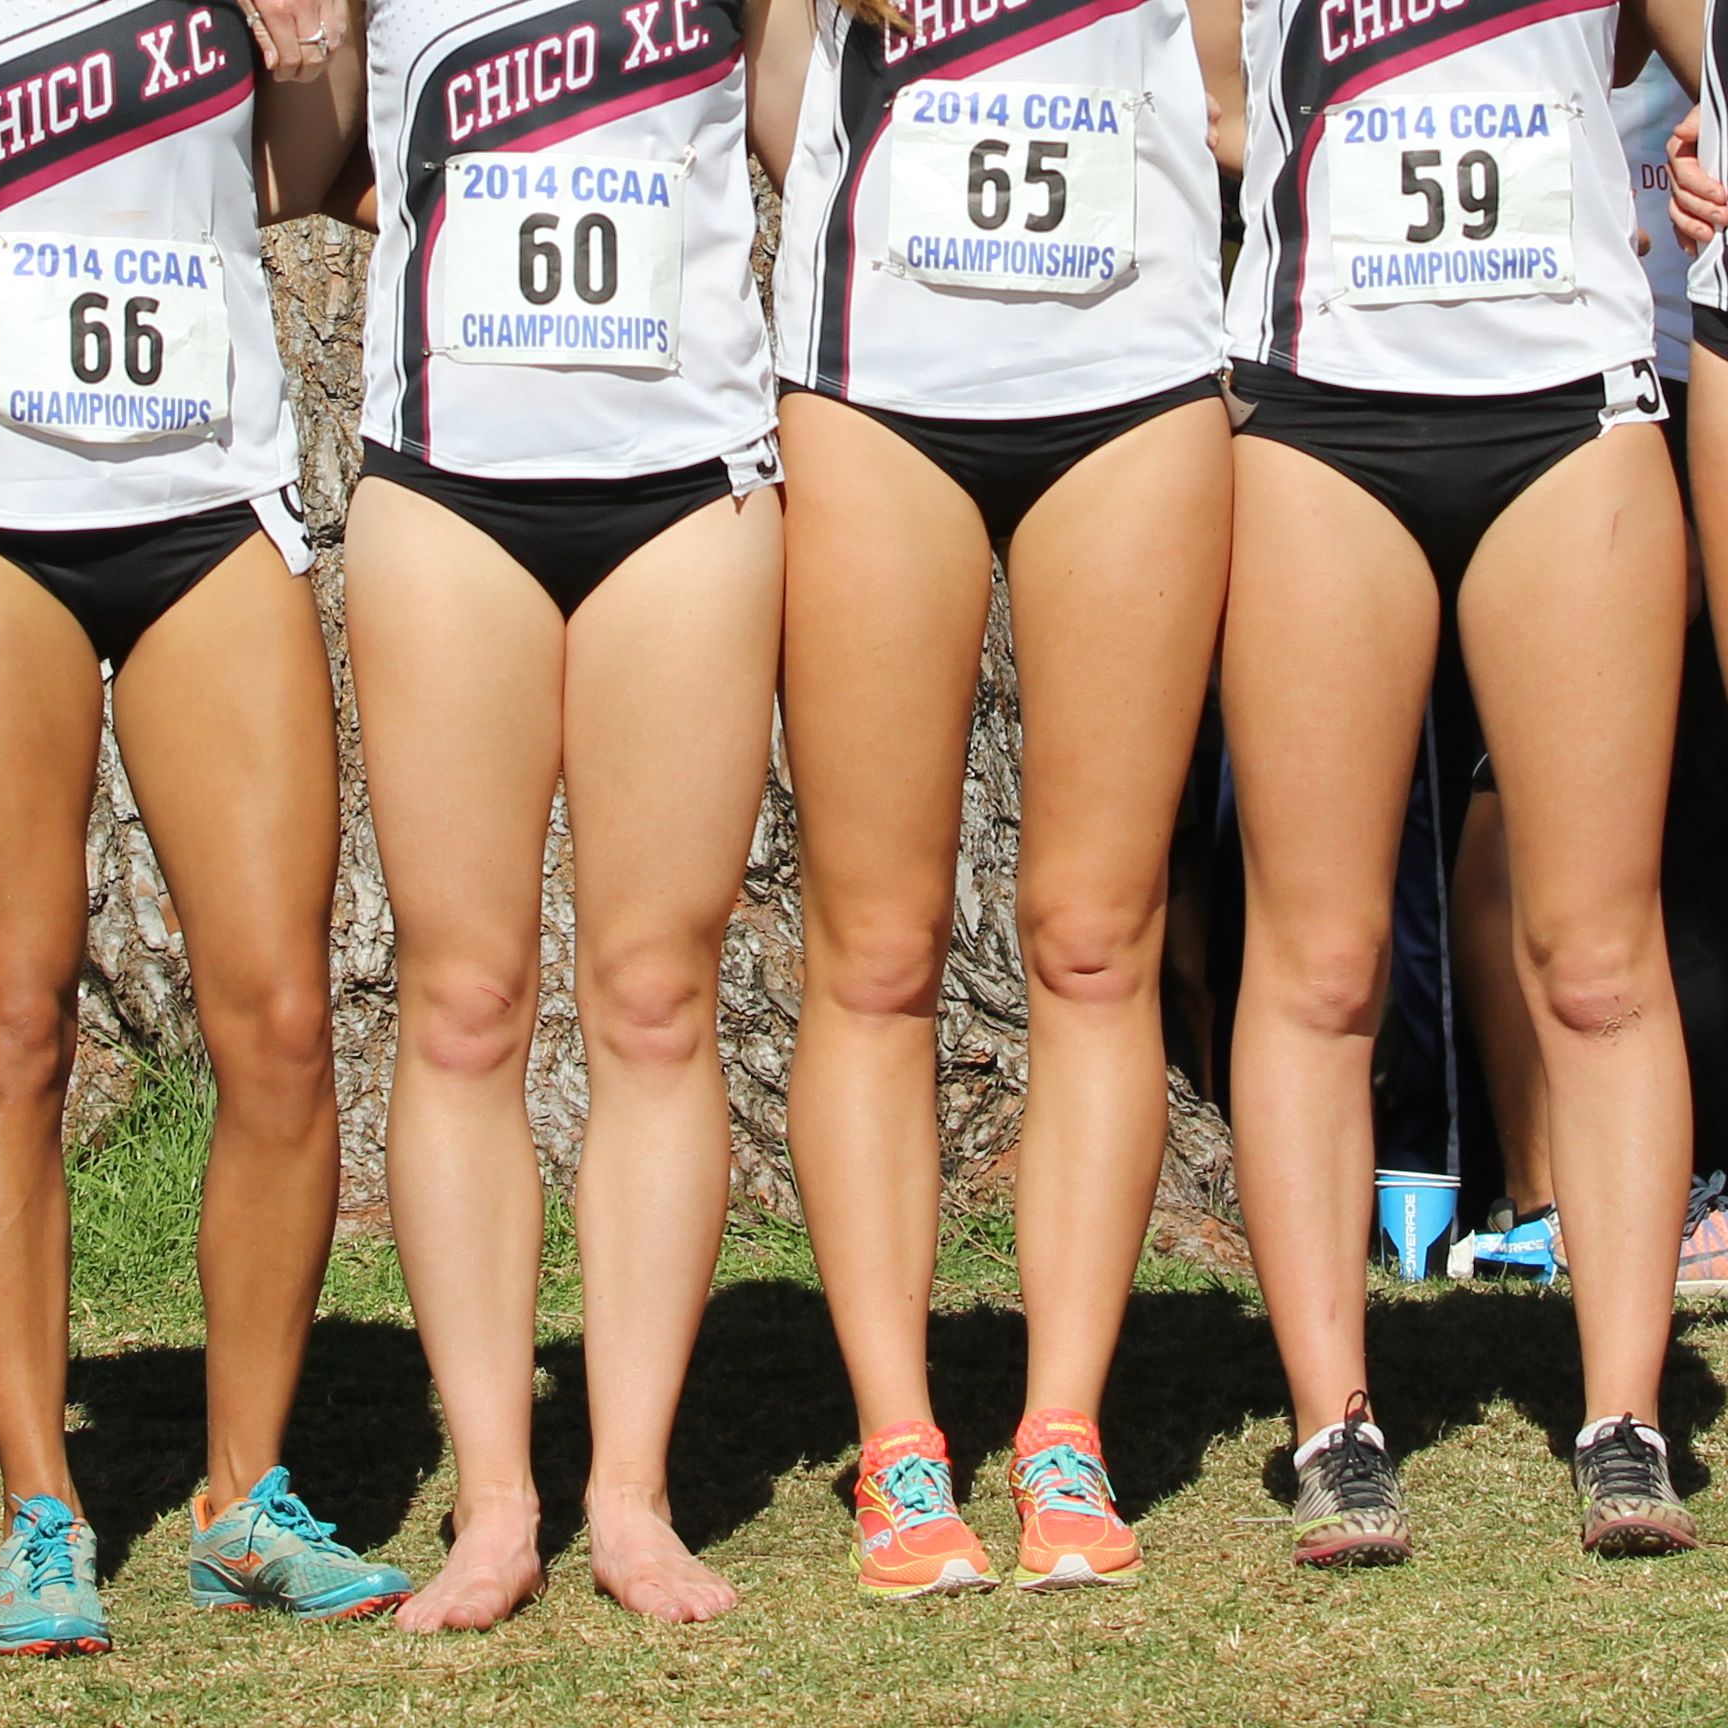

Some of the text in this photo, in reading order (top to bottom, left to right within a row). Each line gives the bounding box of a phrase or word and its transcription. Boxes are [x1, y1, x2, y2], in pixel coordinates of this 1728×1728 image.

[141, 11, 226, 100] X.C.
[447, 26, 596, 141] CHICO
[914, 90, 1119, 134] 2014 CCAA
[1344, 104, 1550, 144] 2014 CCAA
[463, 165, 670, 208] 2014 CCAA
[967, 139, 1068, 232] 65
[1401, 149, 1500, 244] 59
[13, 243, 207, 289] 2014 CCAA
[518, 212, 618, 305] 60
[907, 234, 1114, 280] CHAMPIONSHIPS
[1351, 246, 1557, 290] CHAMPIONSHIPS
[69, 292, 164, 386] 66
[462, 313, 668, 354] CHAMPIONSHIPS
[10, 389, 211, 430] CHAMPIONSHIPS
[879, 1433, 921, 1451] saucony
[1046, 1422, 1087, 1435] saucony
